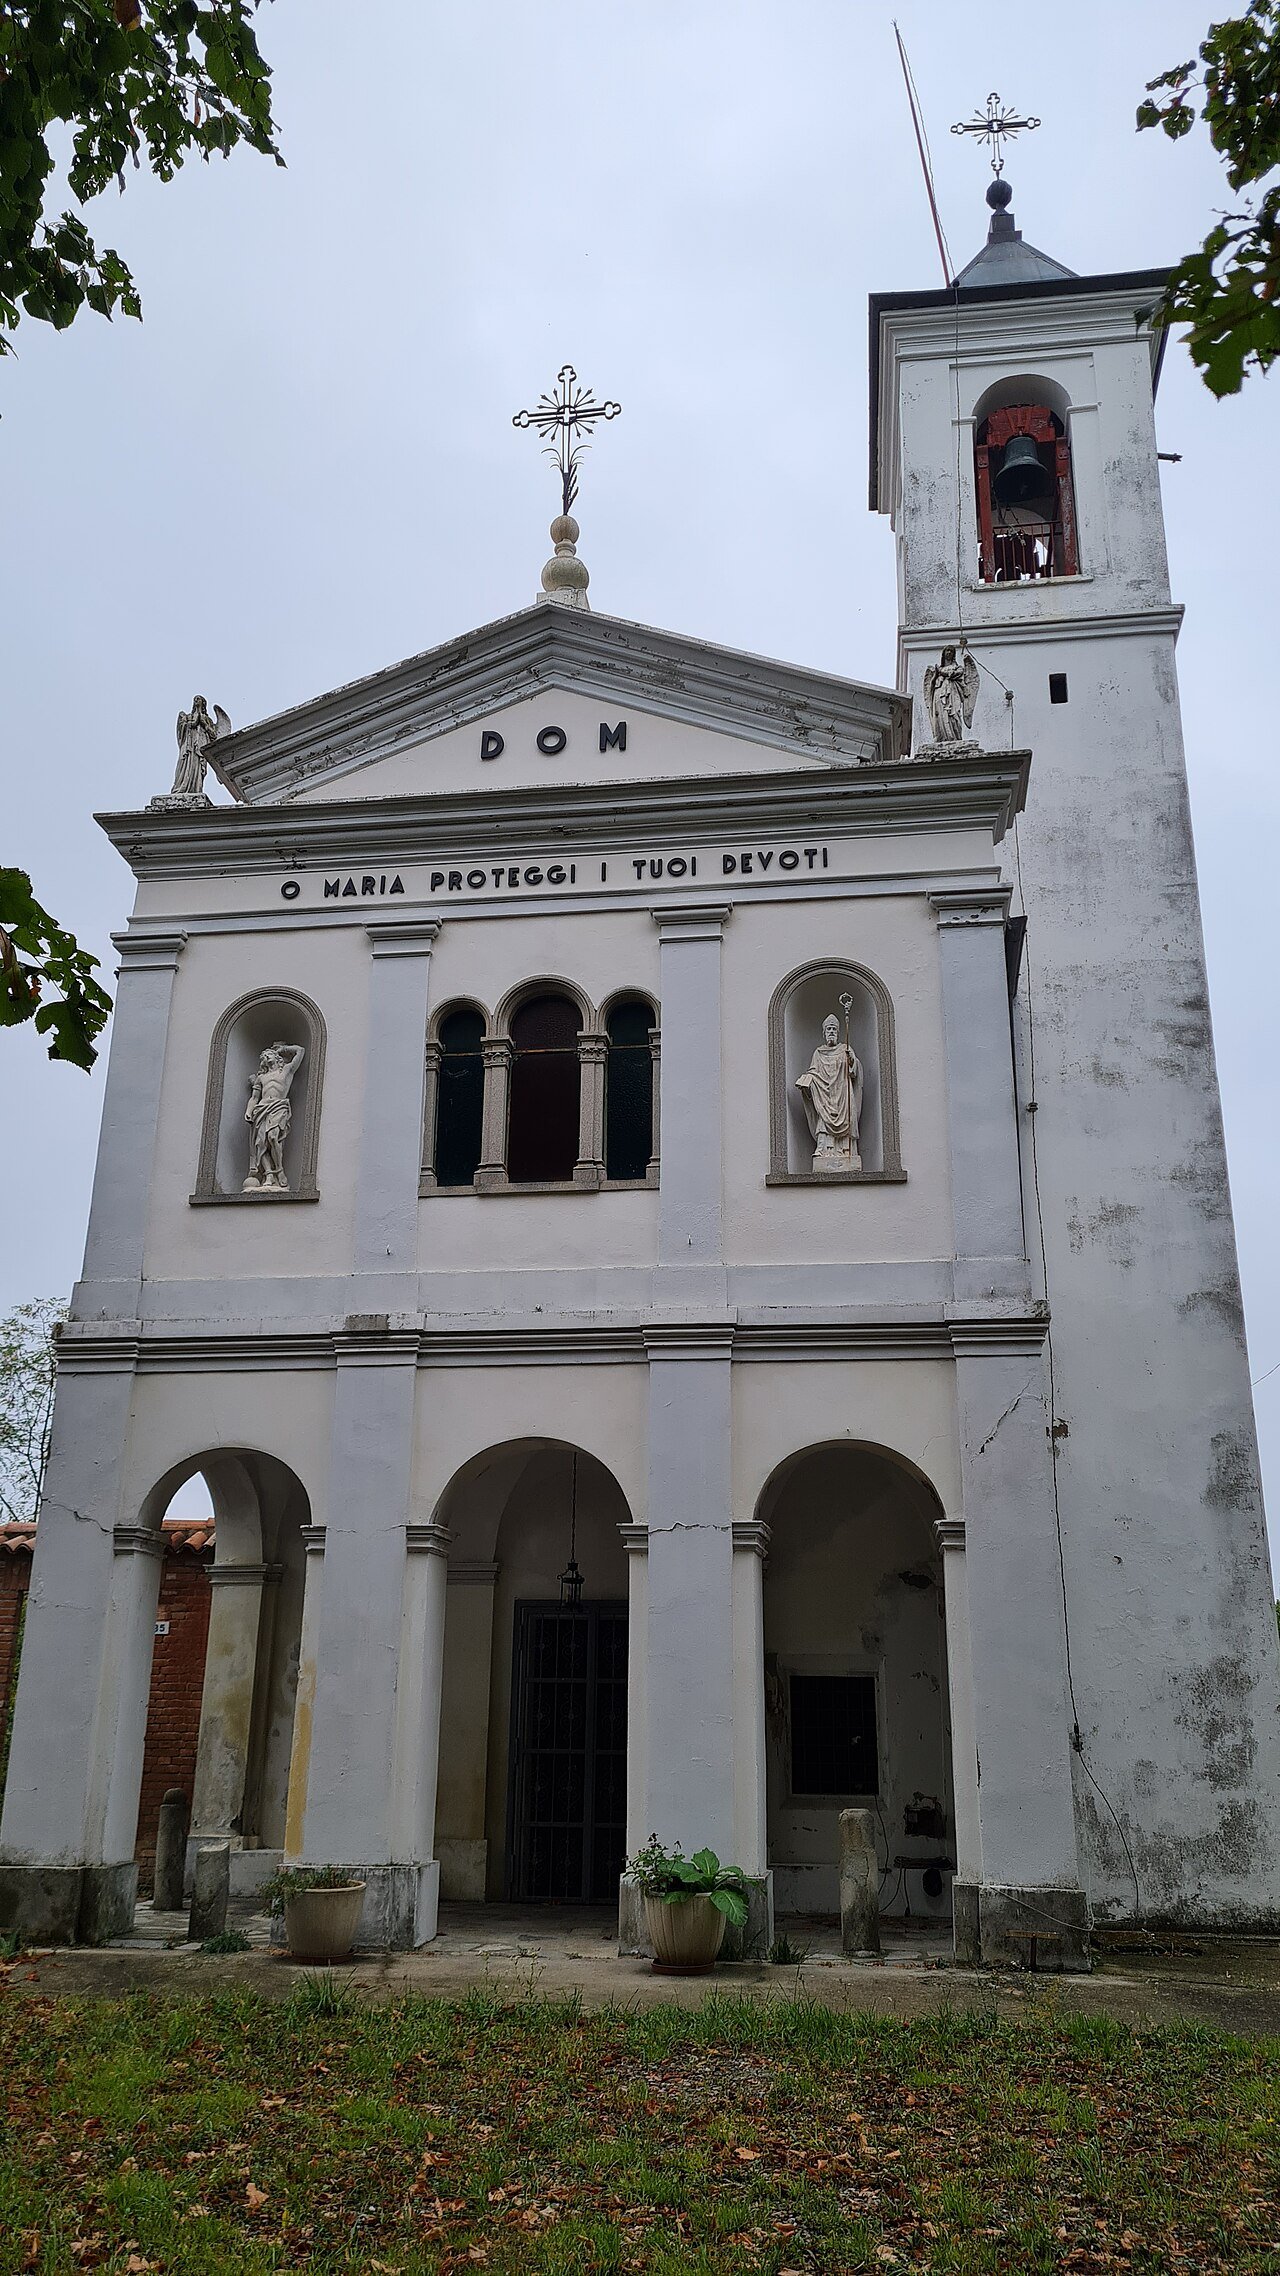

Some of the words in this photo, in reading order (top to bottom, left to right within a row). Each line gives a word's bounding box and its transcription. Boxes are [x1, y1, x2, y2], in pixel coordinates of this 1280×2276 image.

[280, 880, 301, 901] O
[323, 874, 406, 899] MARIA
[430, 864, 577, 893] PROTEGGI
[600, 861, 607, 883] I
[632, 856, 697, 881] TUOI
[722, 847, 829, 875] DEVOTI
